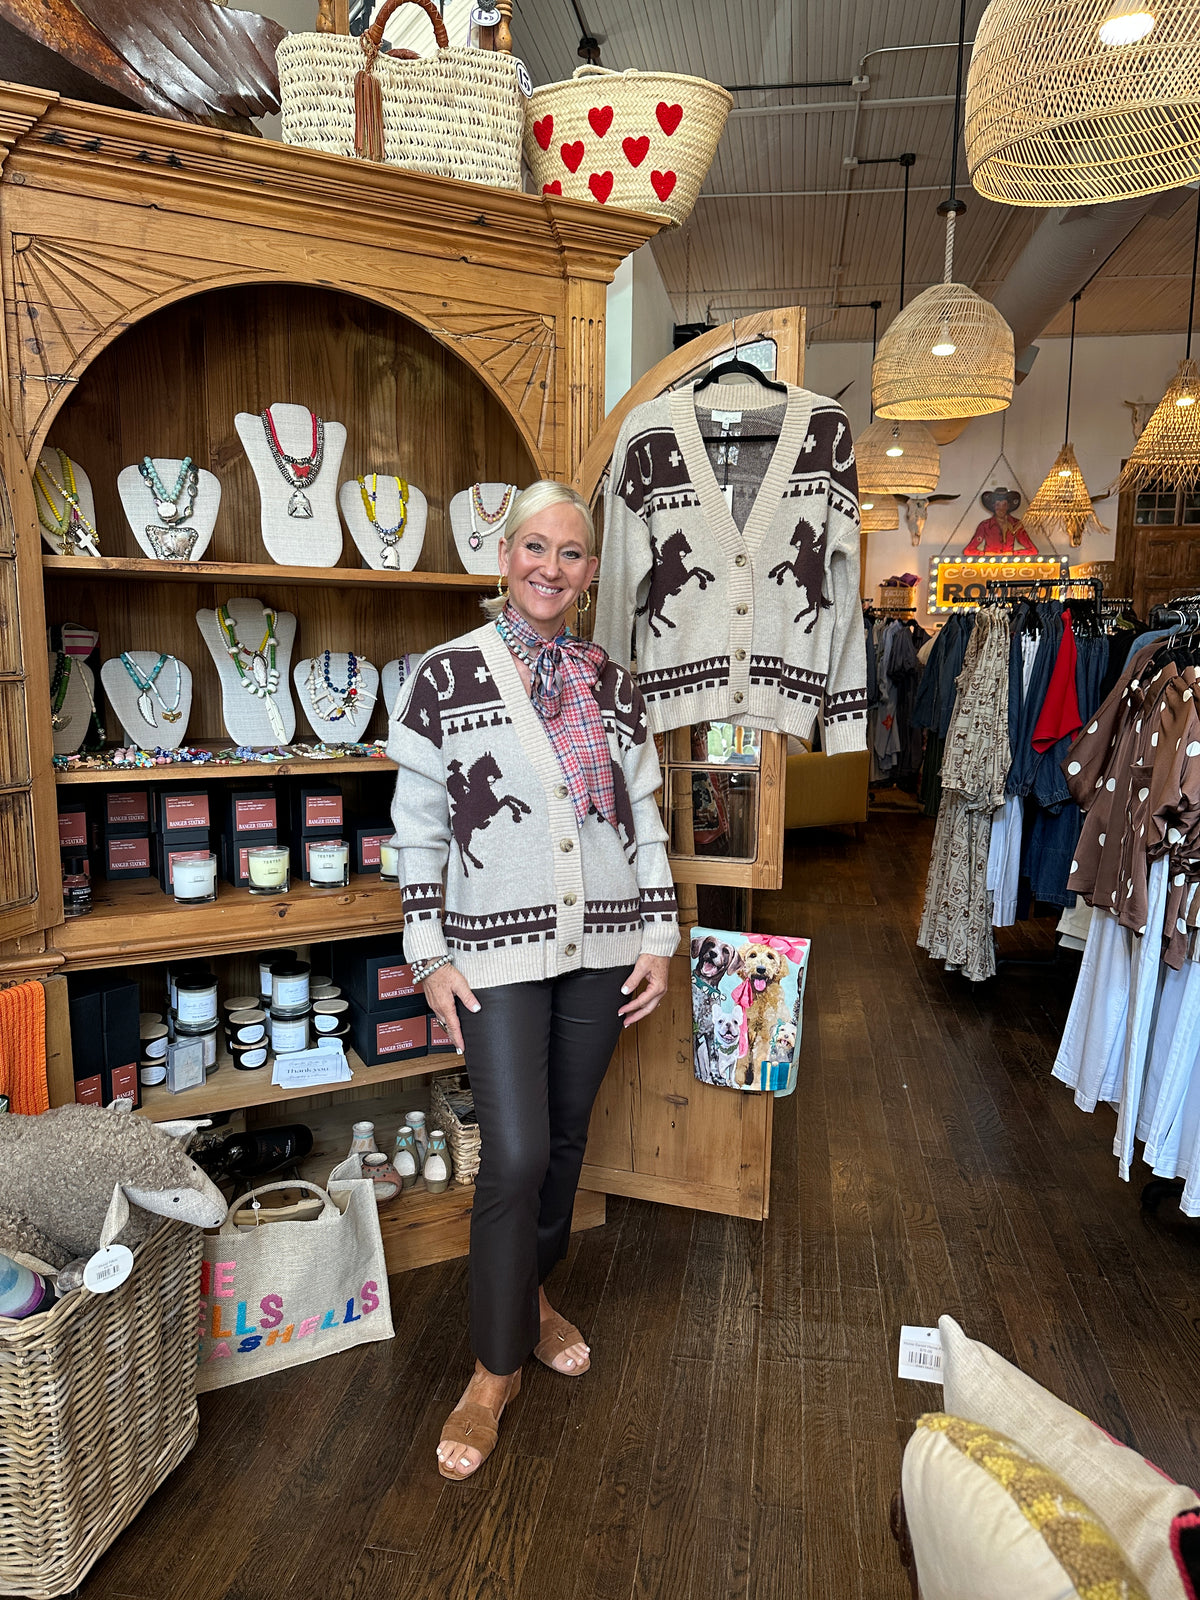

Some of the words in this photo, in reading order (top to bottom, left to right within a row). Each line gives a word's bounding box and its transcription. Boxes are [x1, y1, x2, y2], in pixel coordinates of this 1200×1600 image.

[944, 566, 1056, 578] COWBOY
[381, 990, 398, 998] RANGER
[398, 988, 415, 996] STATION
[379, 1045, 396, 1053] RANGER
[397, 1042, 413, 1050] STATION
[198, 1280, 380, 1364] ASHELLS
